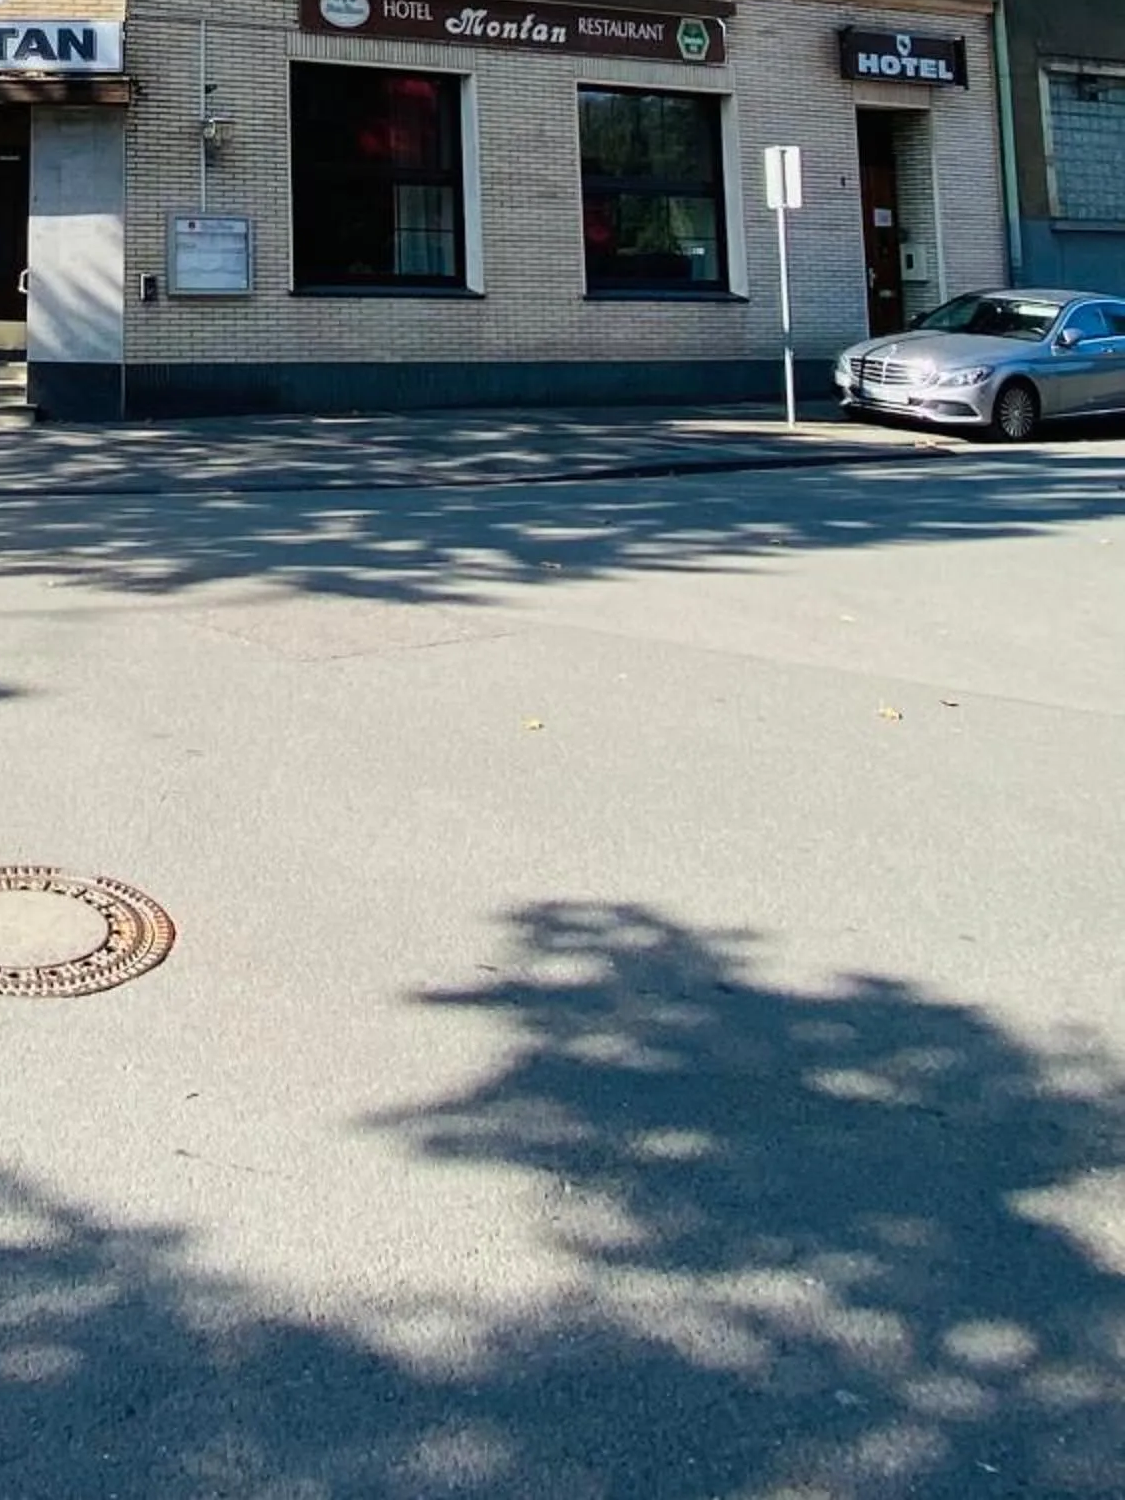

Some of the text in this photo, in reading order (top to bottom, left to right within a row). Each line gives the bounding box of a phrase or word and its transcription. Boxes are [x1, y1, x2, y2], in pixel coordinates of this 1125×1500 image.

[383, 0, 434, 21] HOTEL
[444, 7, 567, 43] Montan
[578, 17, 665, 41] RESTAURANT
[858, 52, 954, 81] HOTEL
